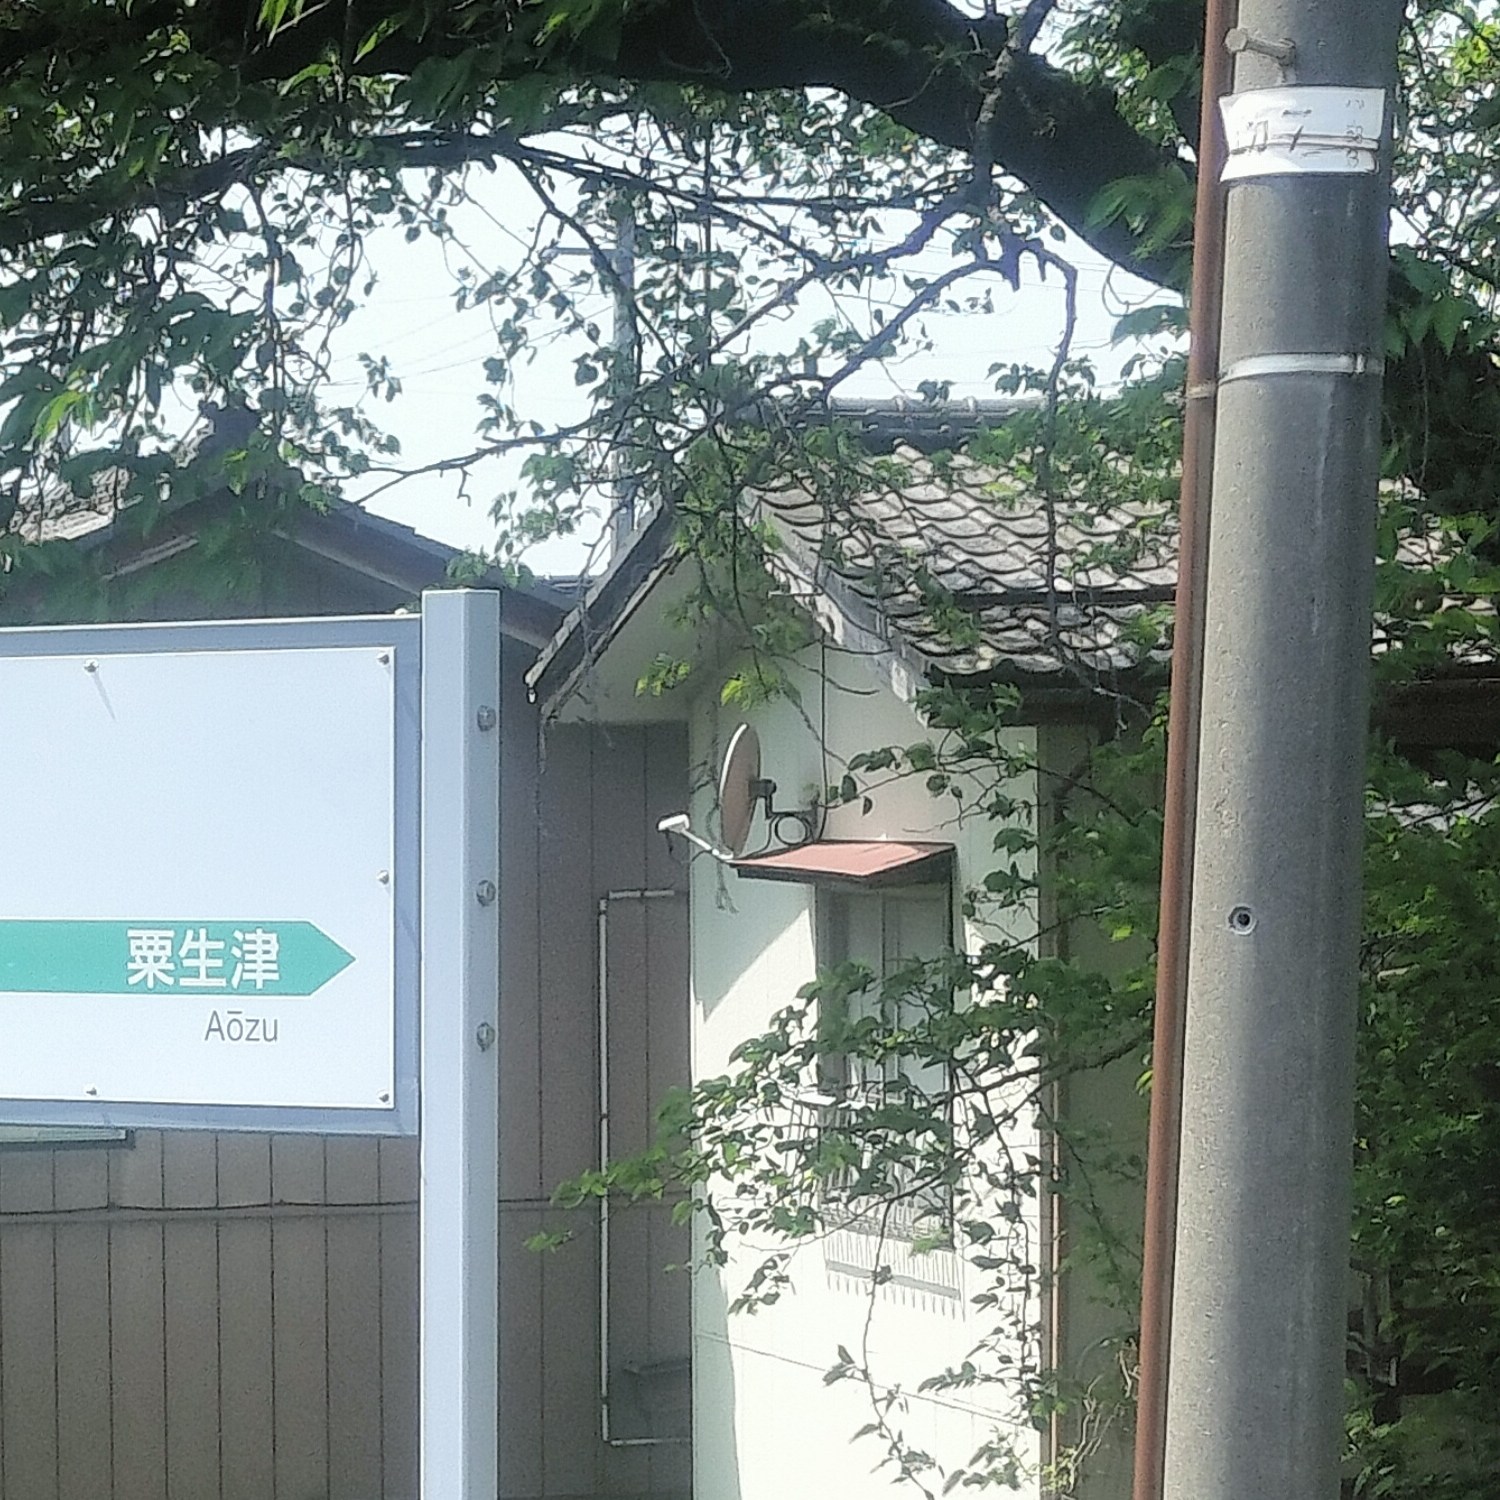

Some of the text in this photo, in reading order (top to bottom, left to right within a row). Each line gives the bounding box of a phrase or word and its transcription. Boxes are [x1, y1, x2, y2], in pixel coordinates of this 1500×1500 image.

[126, 927, 280, 989] 粟生津
[204, 1010, 279, 1042] Aōzu
